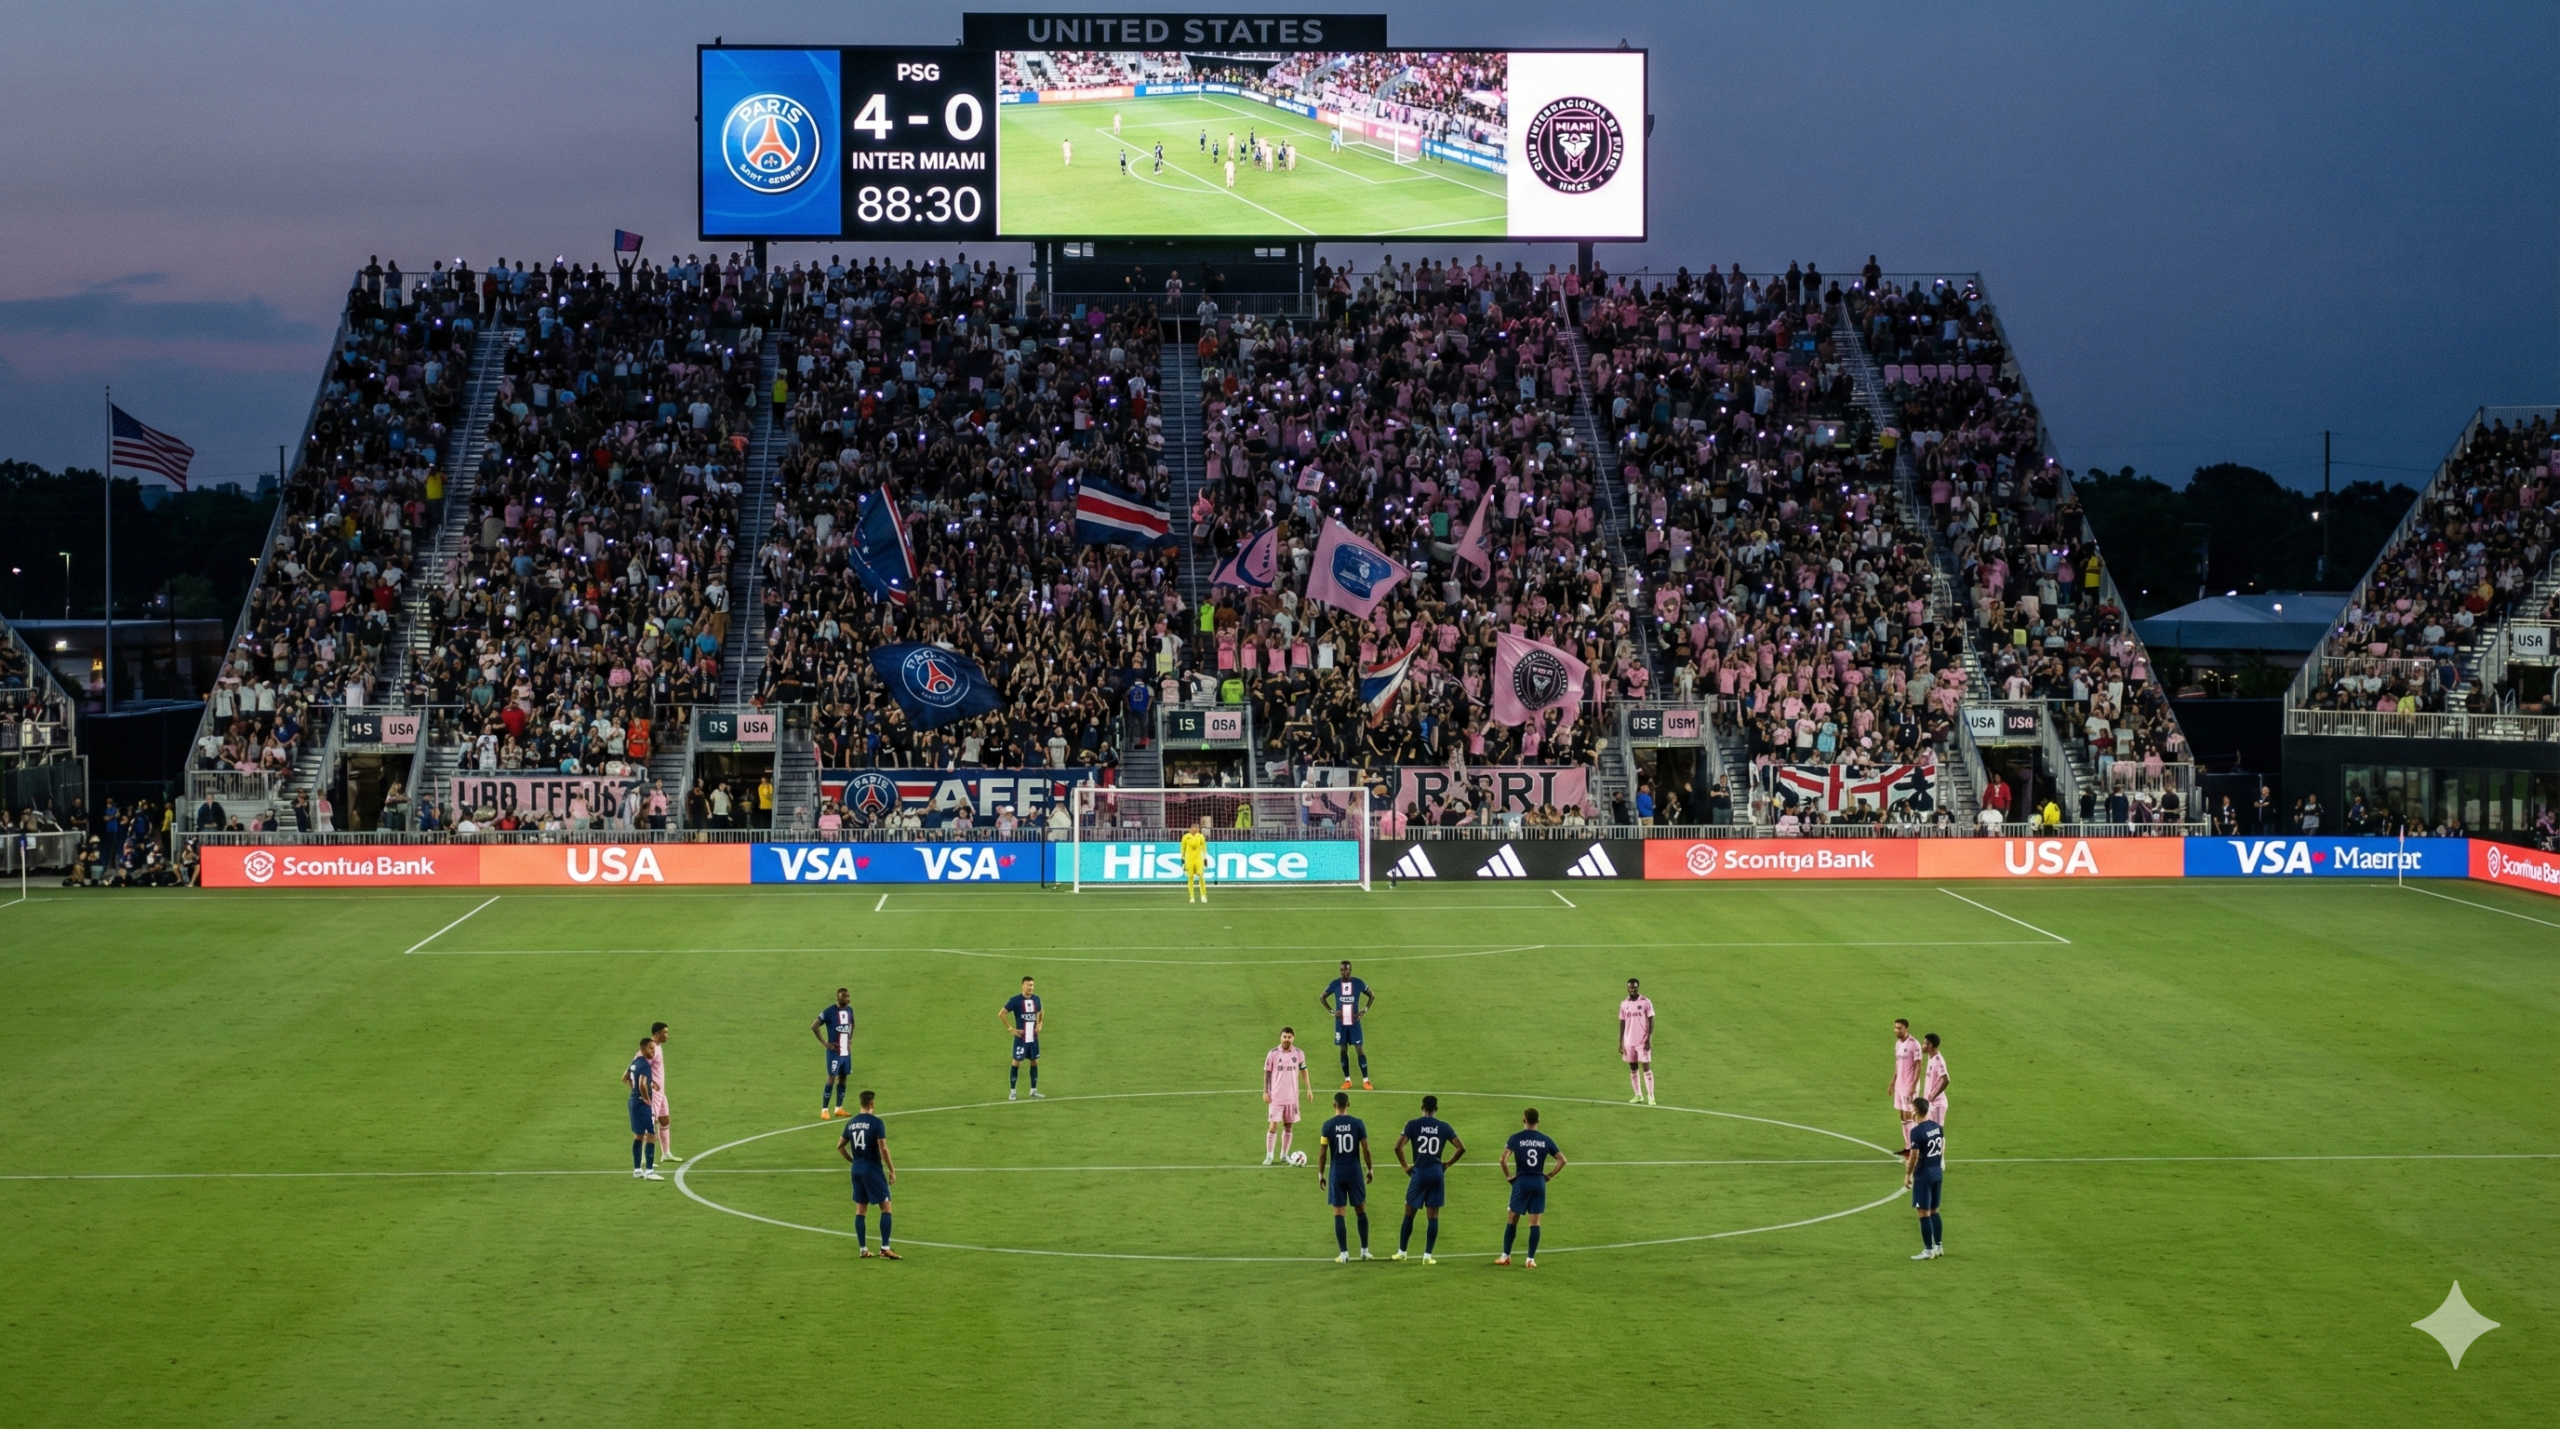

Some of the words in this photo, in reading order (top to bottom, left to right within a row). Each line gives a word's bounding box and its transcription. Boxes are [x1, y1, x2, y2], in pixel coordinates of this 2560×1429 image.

[1027, 18, 1169, 43] UNITED
[1183, 18, 1323, 43] STATES
[897, 63, 940, 81] PSG
[738, 98, 803, 124] PARIS
[853, 94, 893, 140] 4
[944, 93, 983, 141] 0
[1555, 121, 1595, 131] MIAMI
[852, 152, 915, 170] INTER
[919, 152, 985, 170] MIAMI
[857, 186, 981, 222] 88:30
[2518, 634, 2543, 647] USA
[389, 723, 414, 735] USA
[743, 721, 768, 733] USA
[1971, 716, 1995, 728] USA
[376, 856, 435, 875] Bank
[566, 846, 665, 883] USA
[1817, 850, 1875, 868] Bank
[2004, 840, 2100, 875] USA
[852, 1129, 866, 1150] 14
[1336, 1133, 1354, 1154] 10
[1417, 1135, 1440, 1155] 20
[1526, 1148, 1538, 1167] 3
